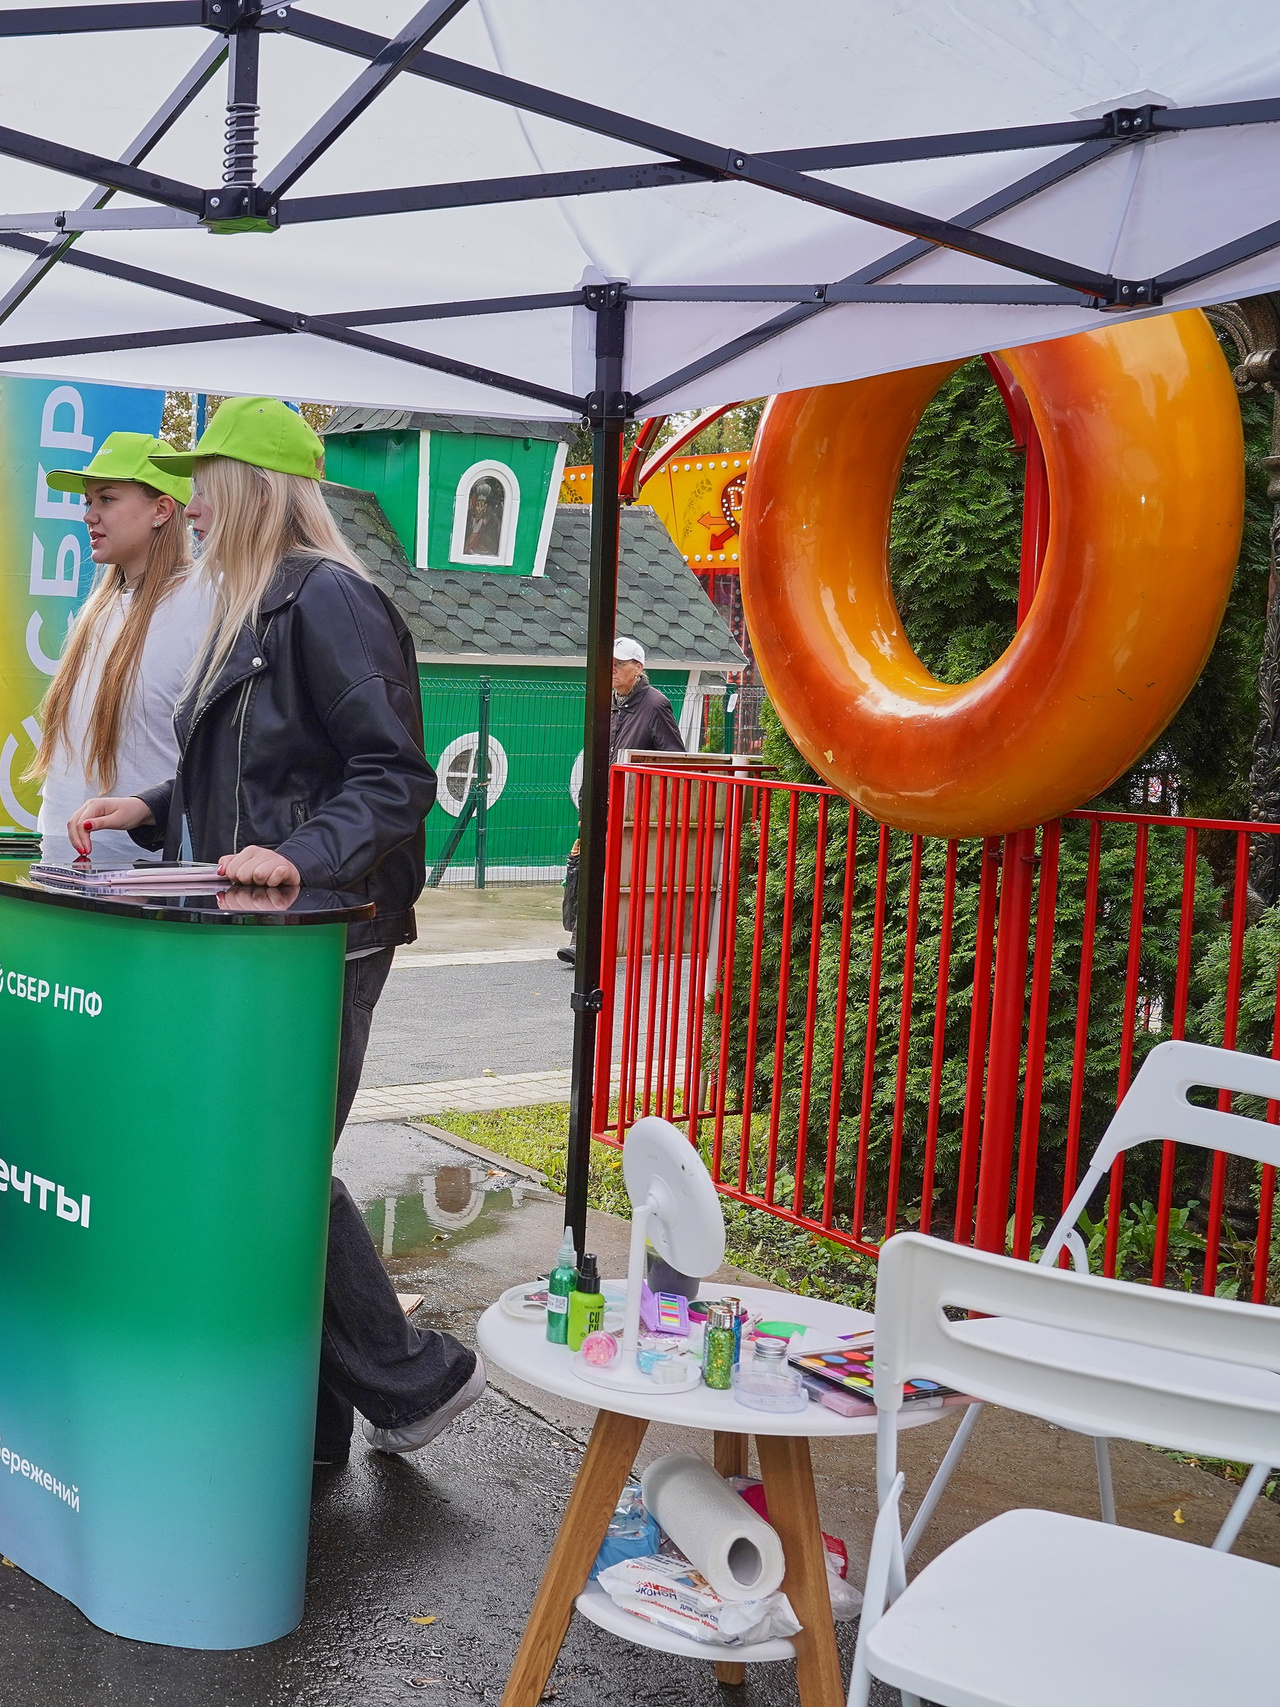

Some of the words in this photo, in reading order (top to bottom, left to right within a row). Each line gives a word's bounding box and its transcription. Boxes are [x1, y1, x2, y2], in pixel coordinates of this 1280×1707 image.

[6, 971, 50, 1003] СБЕР
[53, 983, 103, 1017] НПФ
[589, 1311, 600, 1324] CU
